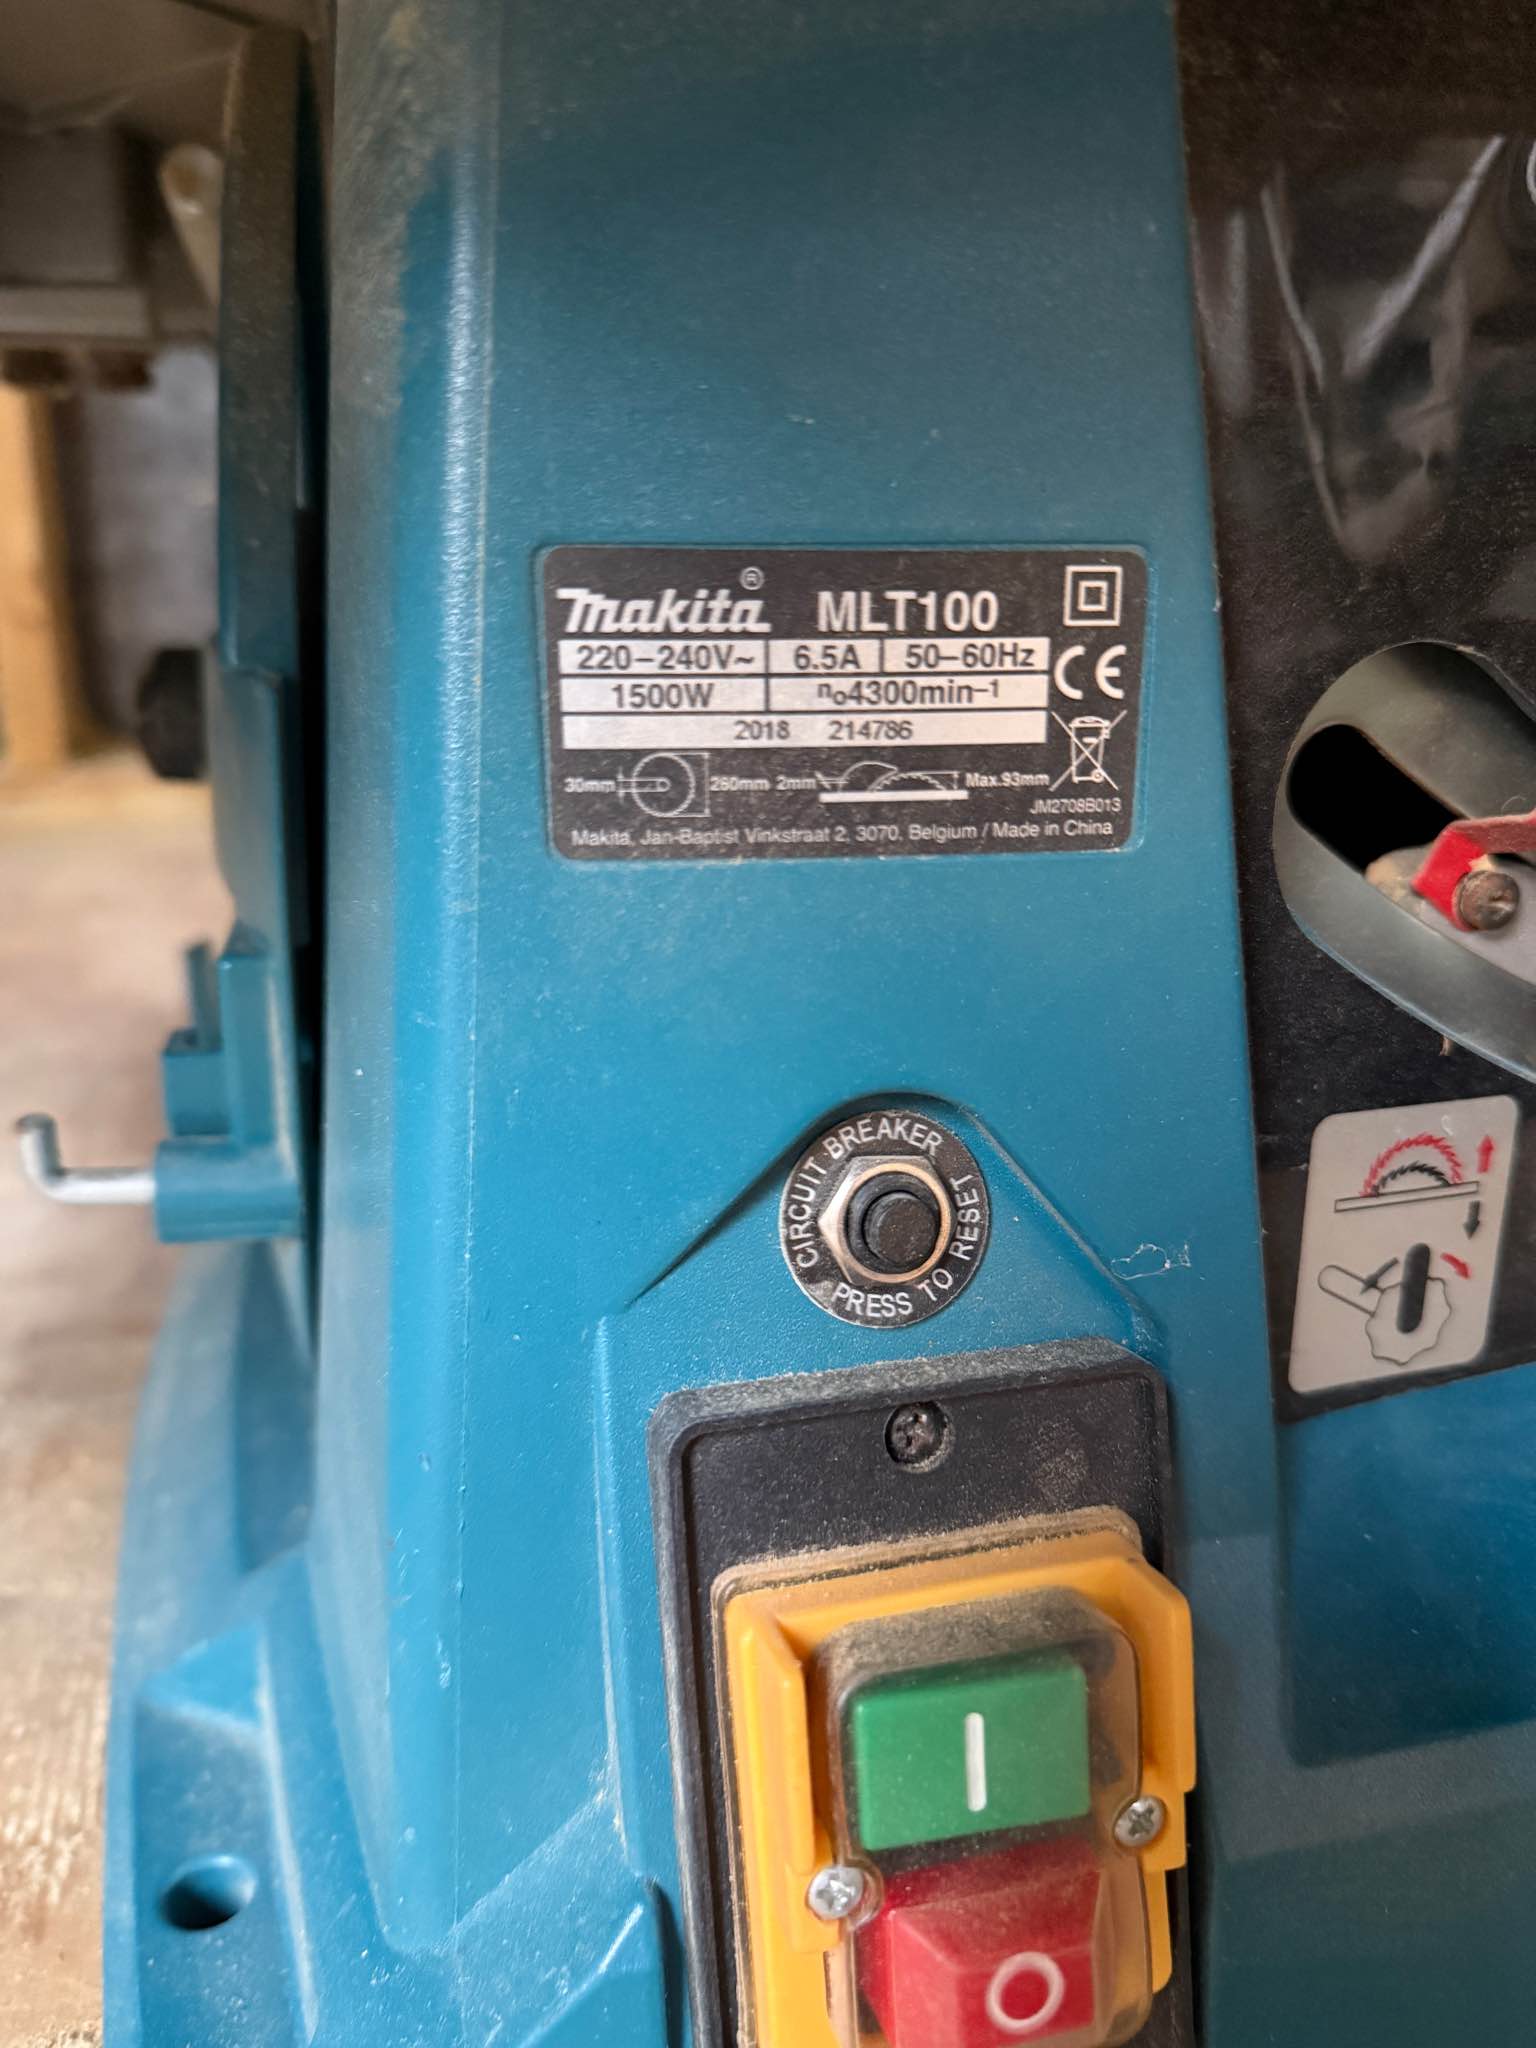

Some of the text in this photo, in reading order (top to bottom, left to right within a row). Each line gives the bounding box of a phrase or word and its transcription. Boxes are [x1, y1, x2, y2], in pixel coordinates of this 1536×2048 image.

[817, 590, 999, 633] MLT100
[794, 644, 861, 670] 6.5A
[905, 643, 1035, 669] 50-60Hz
[1055, 645, 1126, 700] CE
[613, 683, 714, 708] 1500W
[734, 719, 913, 740] 2018 214786
[564, 777, 616, 793] 30mm
[775, 775, 816, 791] 2mm
[966, 772, 1050, 788] Max.93mm
[640, 828, 739, 847] Jan-Baptist
[744, 826, 830, 844] Vinkstraat
[909, 823, 977, 843] Belgium
[982, 822, 990, 838] /
[992, 821, 1040, 838] Made
[1045, 820, 1060, 837] in
[1064, 818, 1113, 836] China
[787, 1117, 944, 1270] CIRCUIT BREAKER
[831, 1174, 981, 1319] PRESS TO RESET
